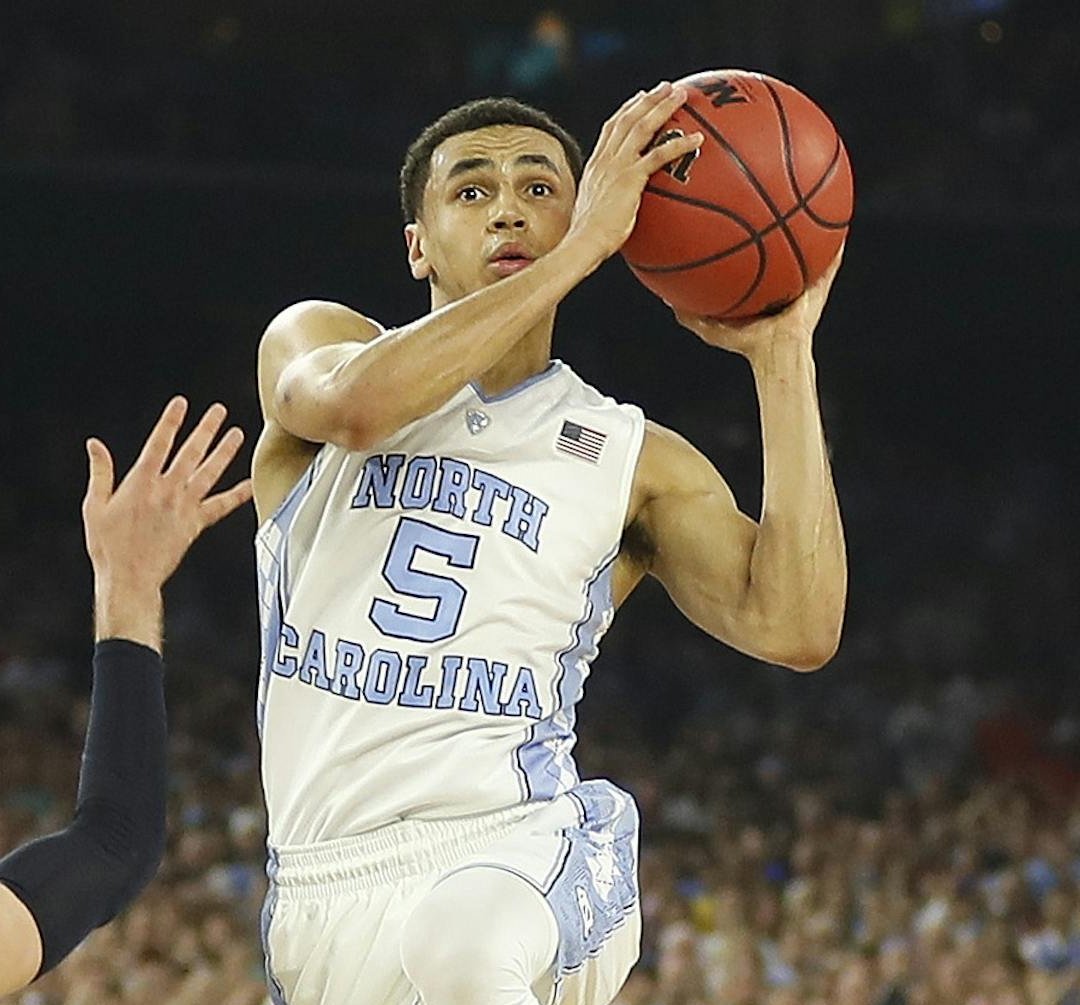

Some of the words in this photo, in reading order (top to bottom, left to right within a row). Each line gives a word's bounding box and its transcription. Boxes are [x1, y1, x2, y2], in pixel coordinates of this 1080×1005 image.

[350, 454, 549, 554] NORTH
[368, 516, 480, 643] 5
[271, 622, 543, 720] CAROLINA
